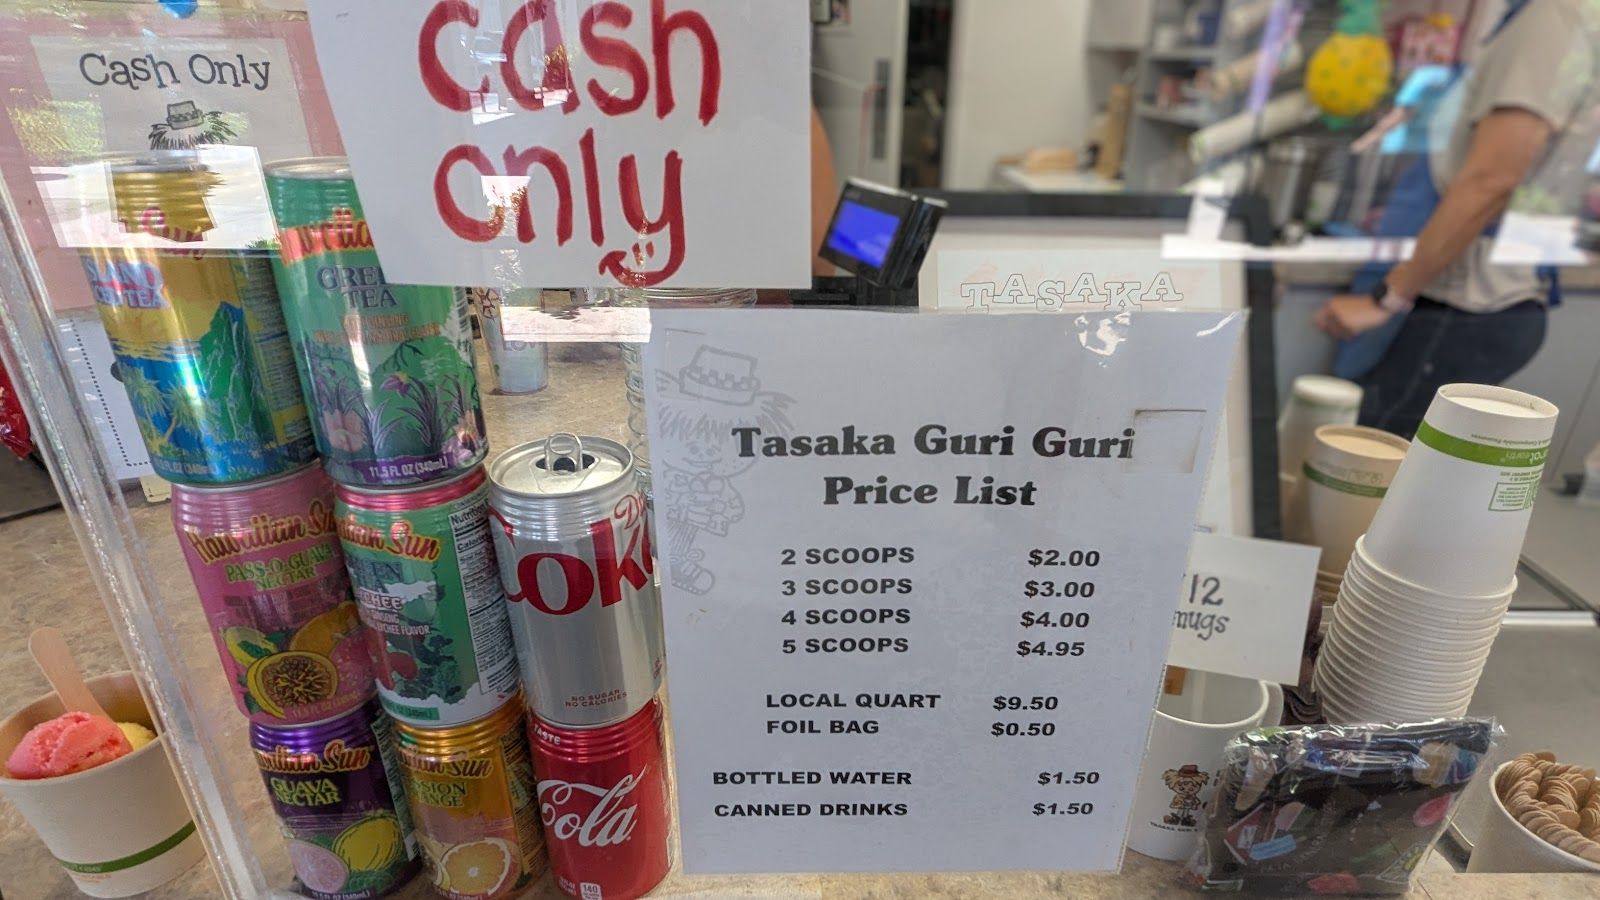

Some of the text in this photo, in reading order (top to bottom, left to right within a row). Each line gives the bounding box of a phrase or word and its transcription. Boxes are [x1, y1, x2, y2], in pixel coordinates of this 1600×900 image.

[79, 53, 271, 91] Cash Only
[418, 0, 721, 127] cash
[433, 128, 686, 287] only
[342, 288, 398, 309] TEA
[960, 272, 1184, 313] TASAKA
[731, 425, 1134, 459] Tasaka Guri Guri
[389, 465, 401, 477] FL
[402, 463, 415, 476] OZ
[823, 476, 1038, 506] Price List
[184, 513, 307, 563] Hawaiian
[386, 520, 441, 560] Sun
[780, 546, 1101, 569] 2 SCOOPS $2.00
[781, 578, 1096, 600] 3 SCOOPS $3.00
[781, 608, 1091, 630] 4 SCOOPS $4.00
[781, 637, 1086, 660] 5 SCOOPS $4.95
[765, 693, 1059, 713] LOCAL QUART $9.50
[533, 723, 561, 745] TASTE
[765, 719, 1056, 739] FOIL BAG $0.50
[321, 739, 371, 773] Sun
[446, 750, 493, 778] Sun
[270, 777, 338, 796] GUAVA
[712, 770, 1101, 787] BOTTLED WATER $1.50
[274, 790, 341, 806] NECTAR
[536, 763, 648, 847] Cola
[714, 802, 1094, 819] CANNED DRINKS $1.50
